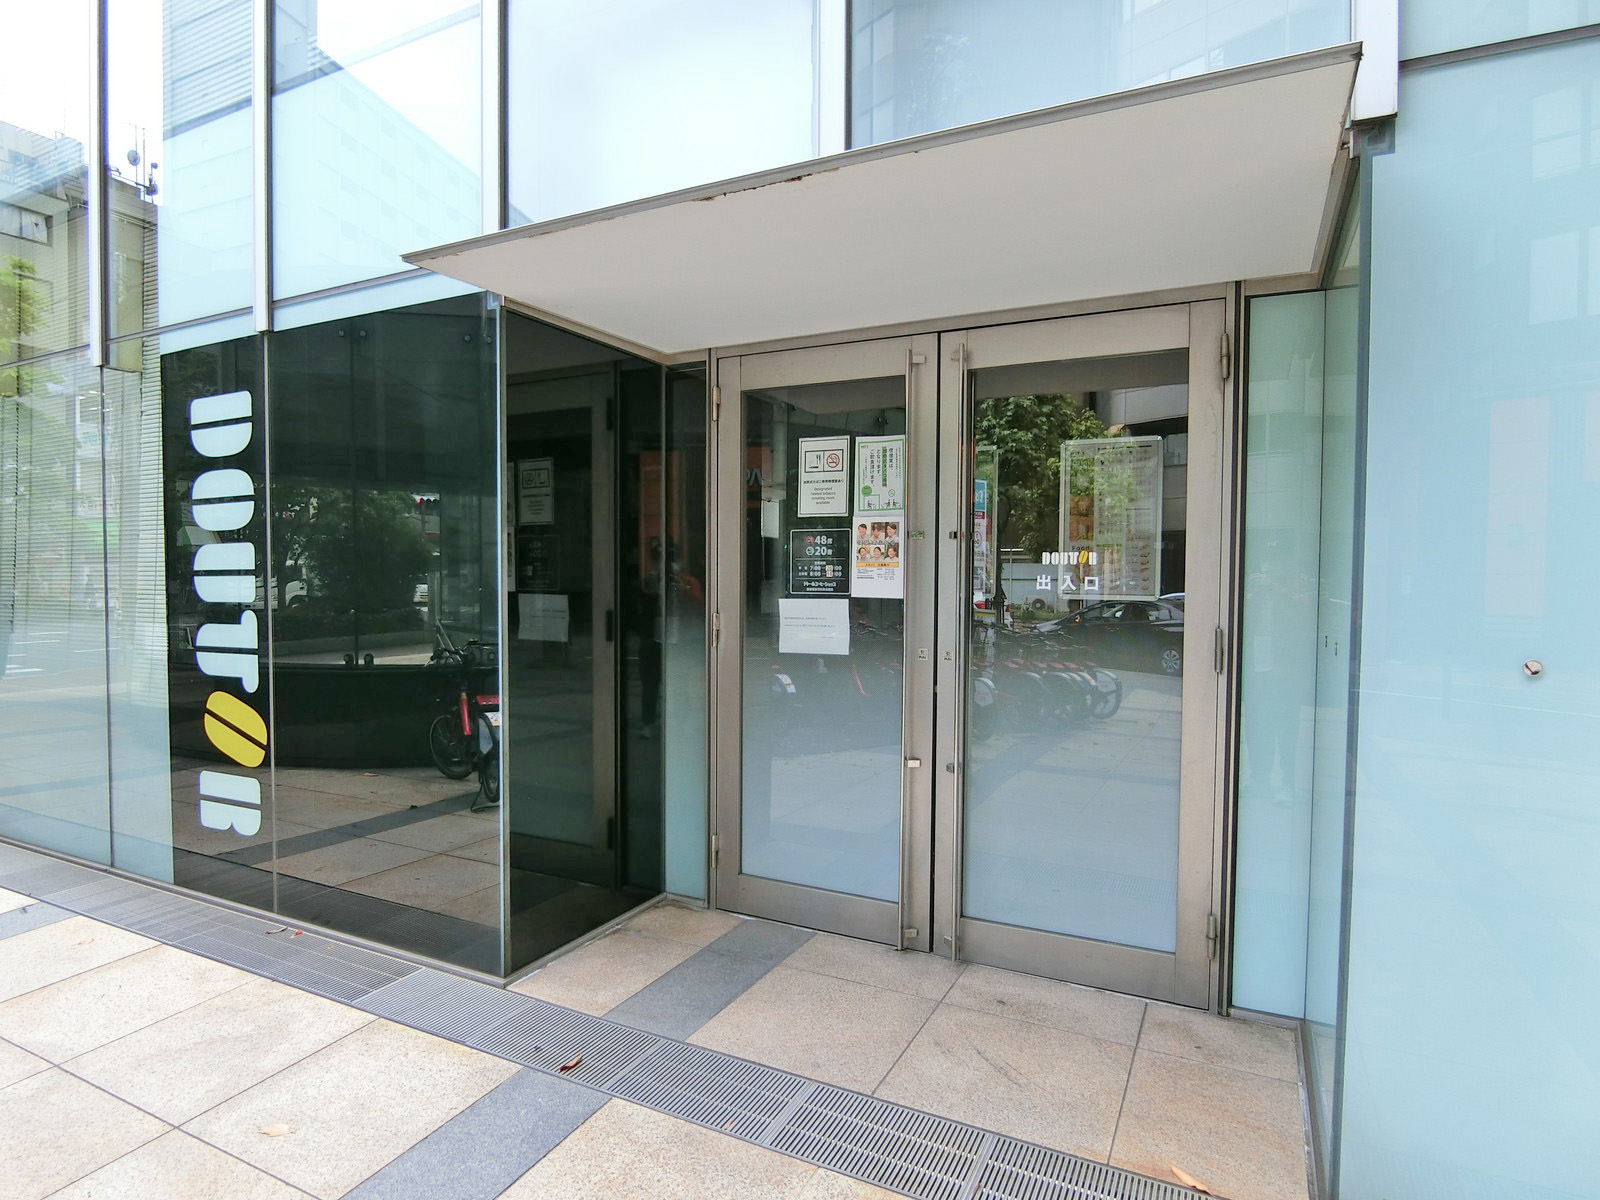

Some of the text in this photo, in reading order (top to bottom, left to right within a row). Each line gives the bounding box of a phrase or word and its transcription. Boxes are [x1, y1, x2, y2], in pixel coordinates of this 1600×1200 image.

[1042, 550, 1097, 566] DOUTOR
[1036, 574, 1099, 591] 出入口
[190, 390, 268, 837] DOUTOR
